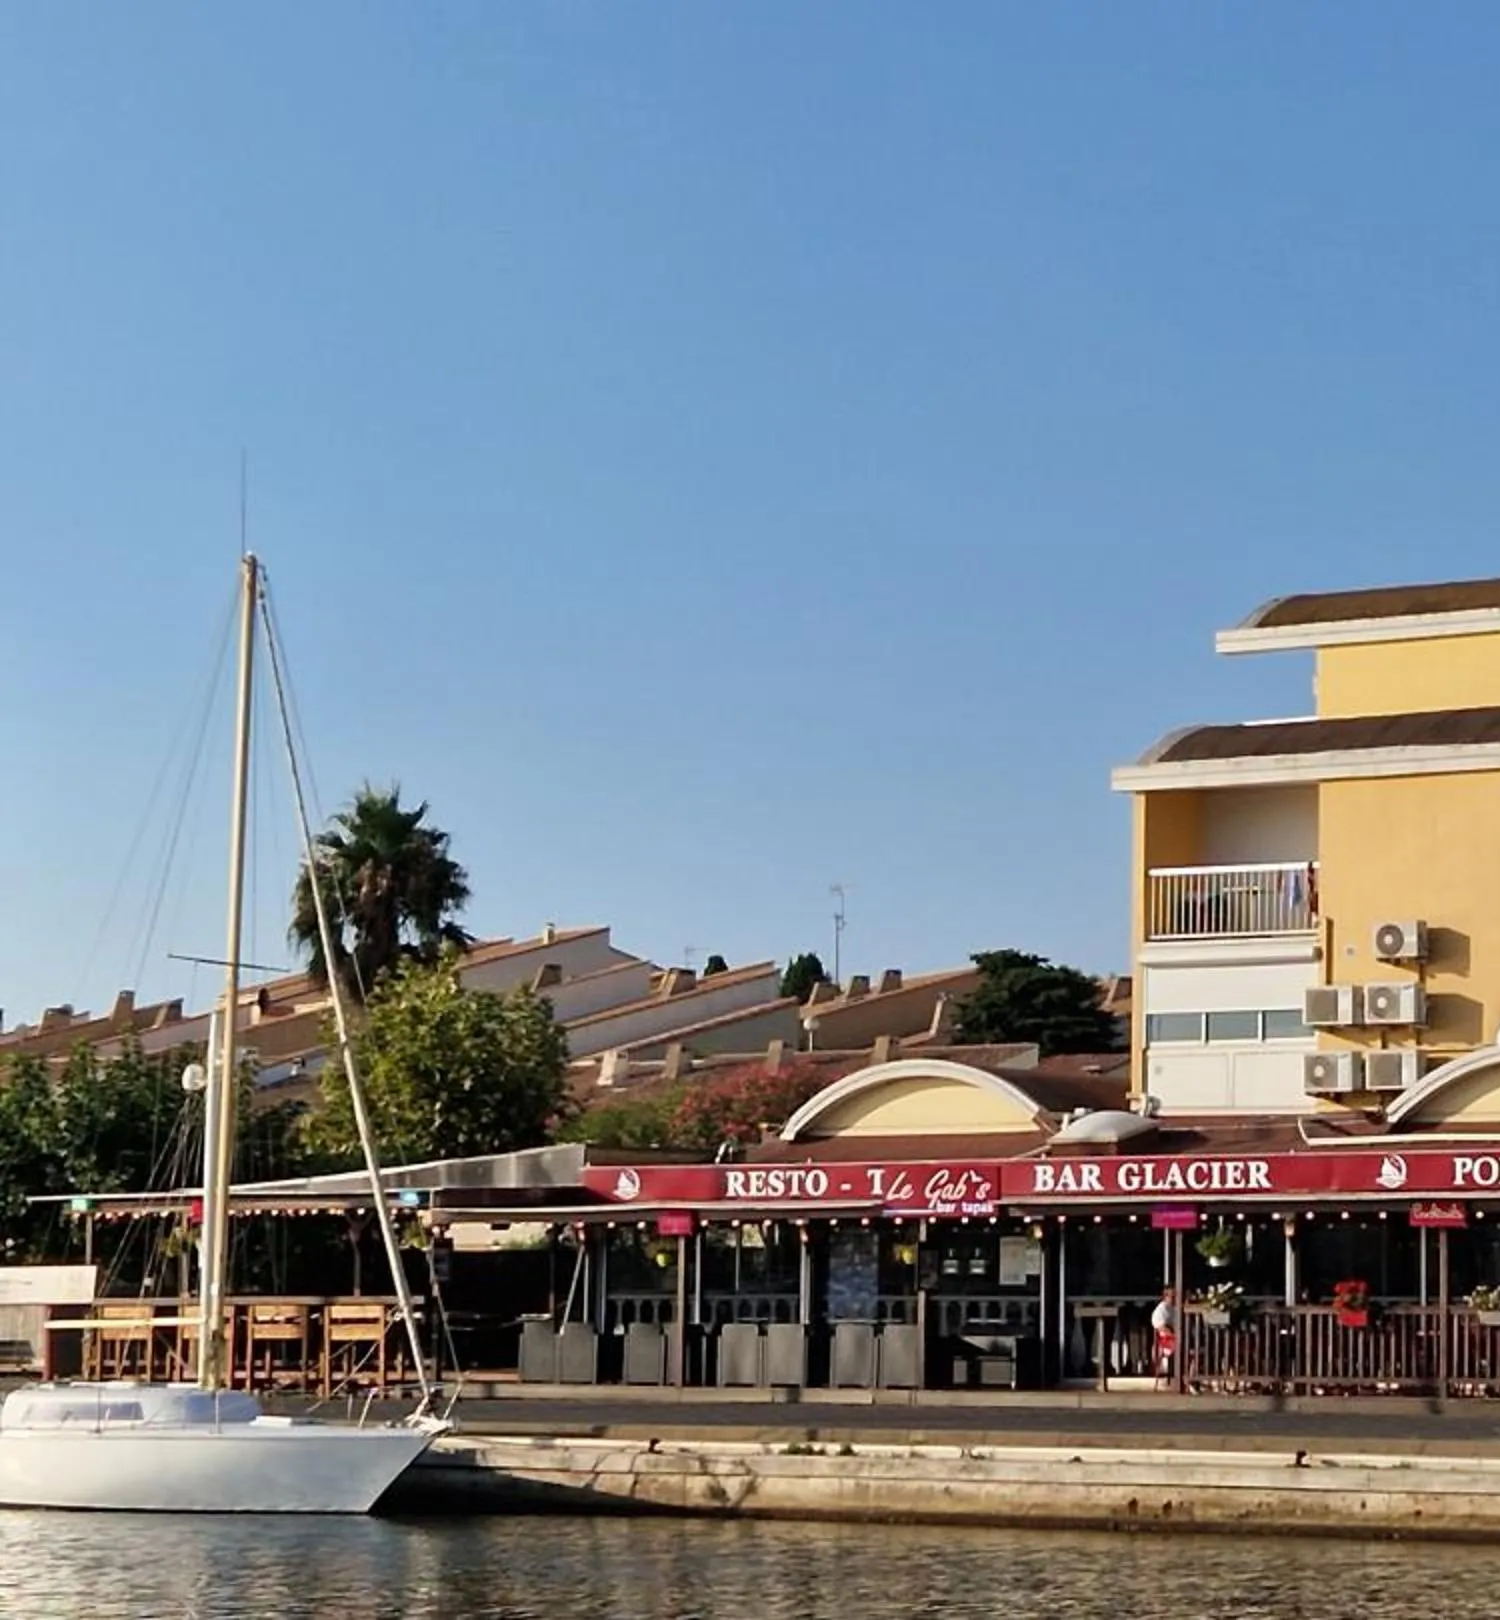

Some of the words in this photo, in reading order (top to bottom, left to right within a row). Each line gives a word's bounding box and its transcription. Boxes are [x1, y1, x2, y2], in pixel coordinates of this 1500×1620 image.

[725, 1168, 829, 1198] RESTO
[885, 1170, 916, 1200] Le
[1034, 1164, 1104, 1191] BAR
[1117, 1161, 1271, 1190] GLACIER
